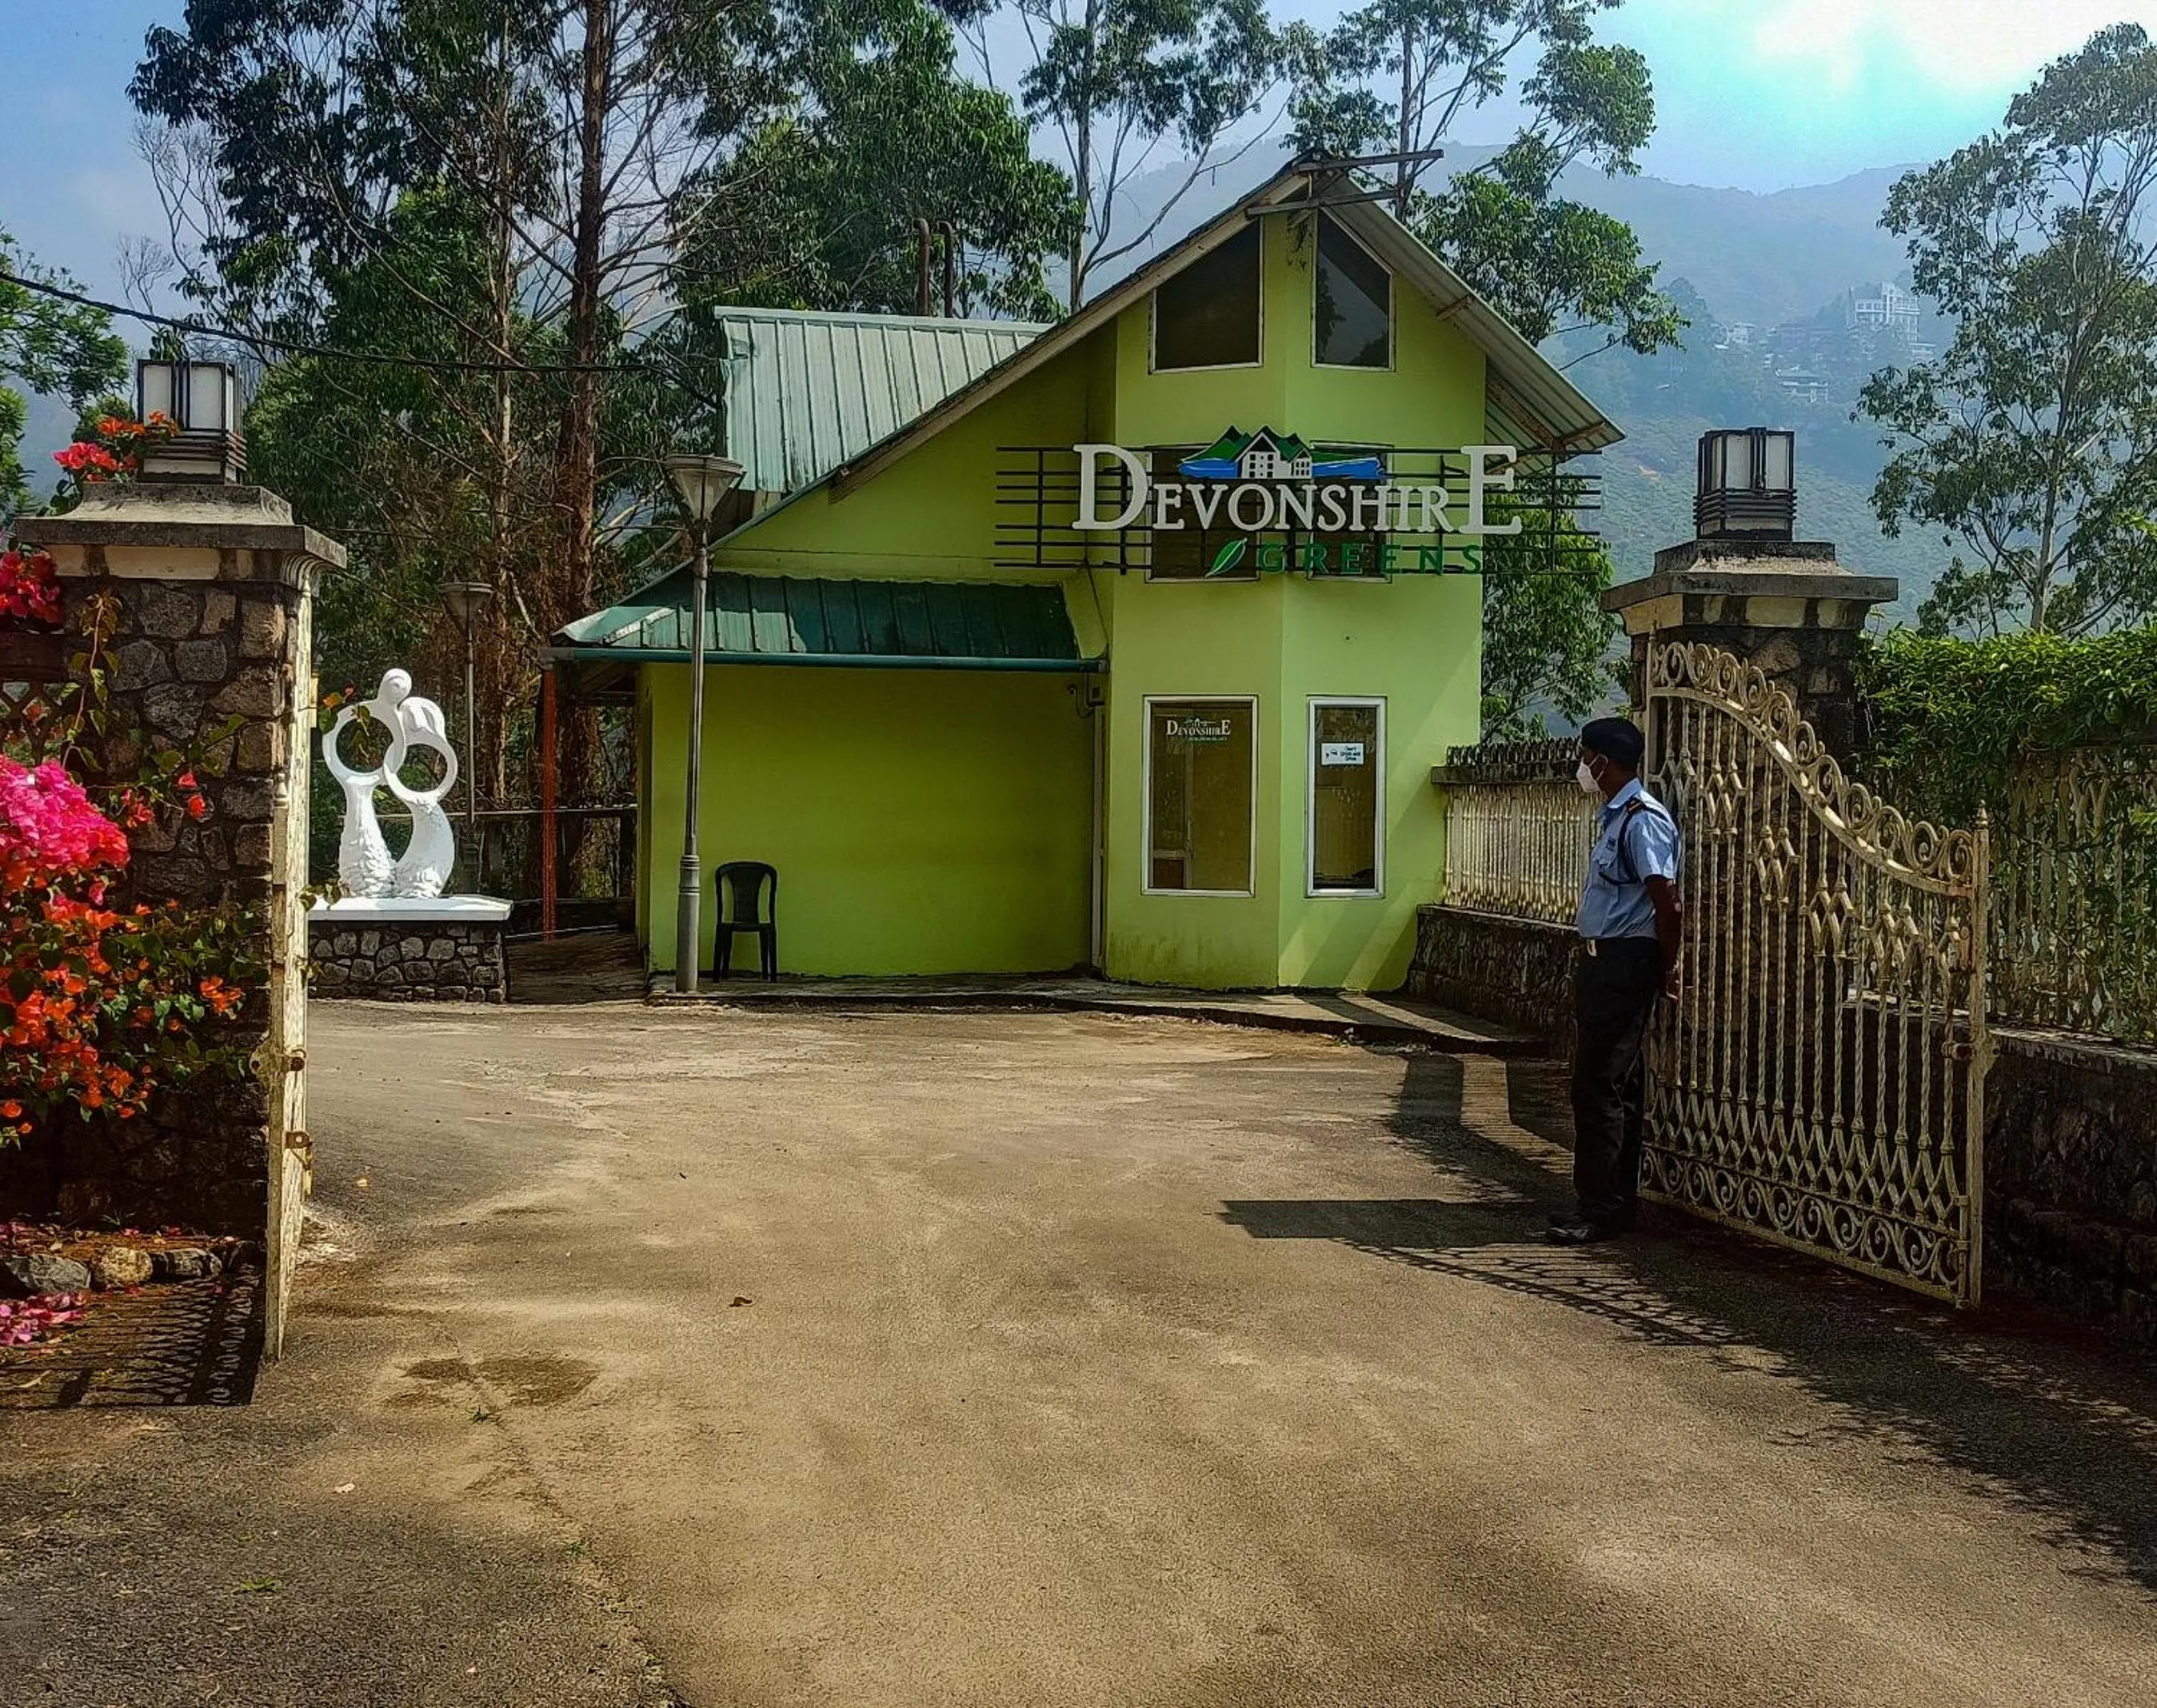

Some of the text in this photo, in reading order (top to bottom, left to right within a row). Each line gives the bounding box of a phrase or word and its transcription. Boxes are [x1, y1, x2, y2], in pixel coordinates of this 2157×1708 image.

[1073, 444, 1521, 534] DEVONSHIRE
[1258, 543, 1483, 575] GREENS
[1167, 720, 1231, 736] DEVONSHIRE
